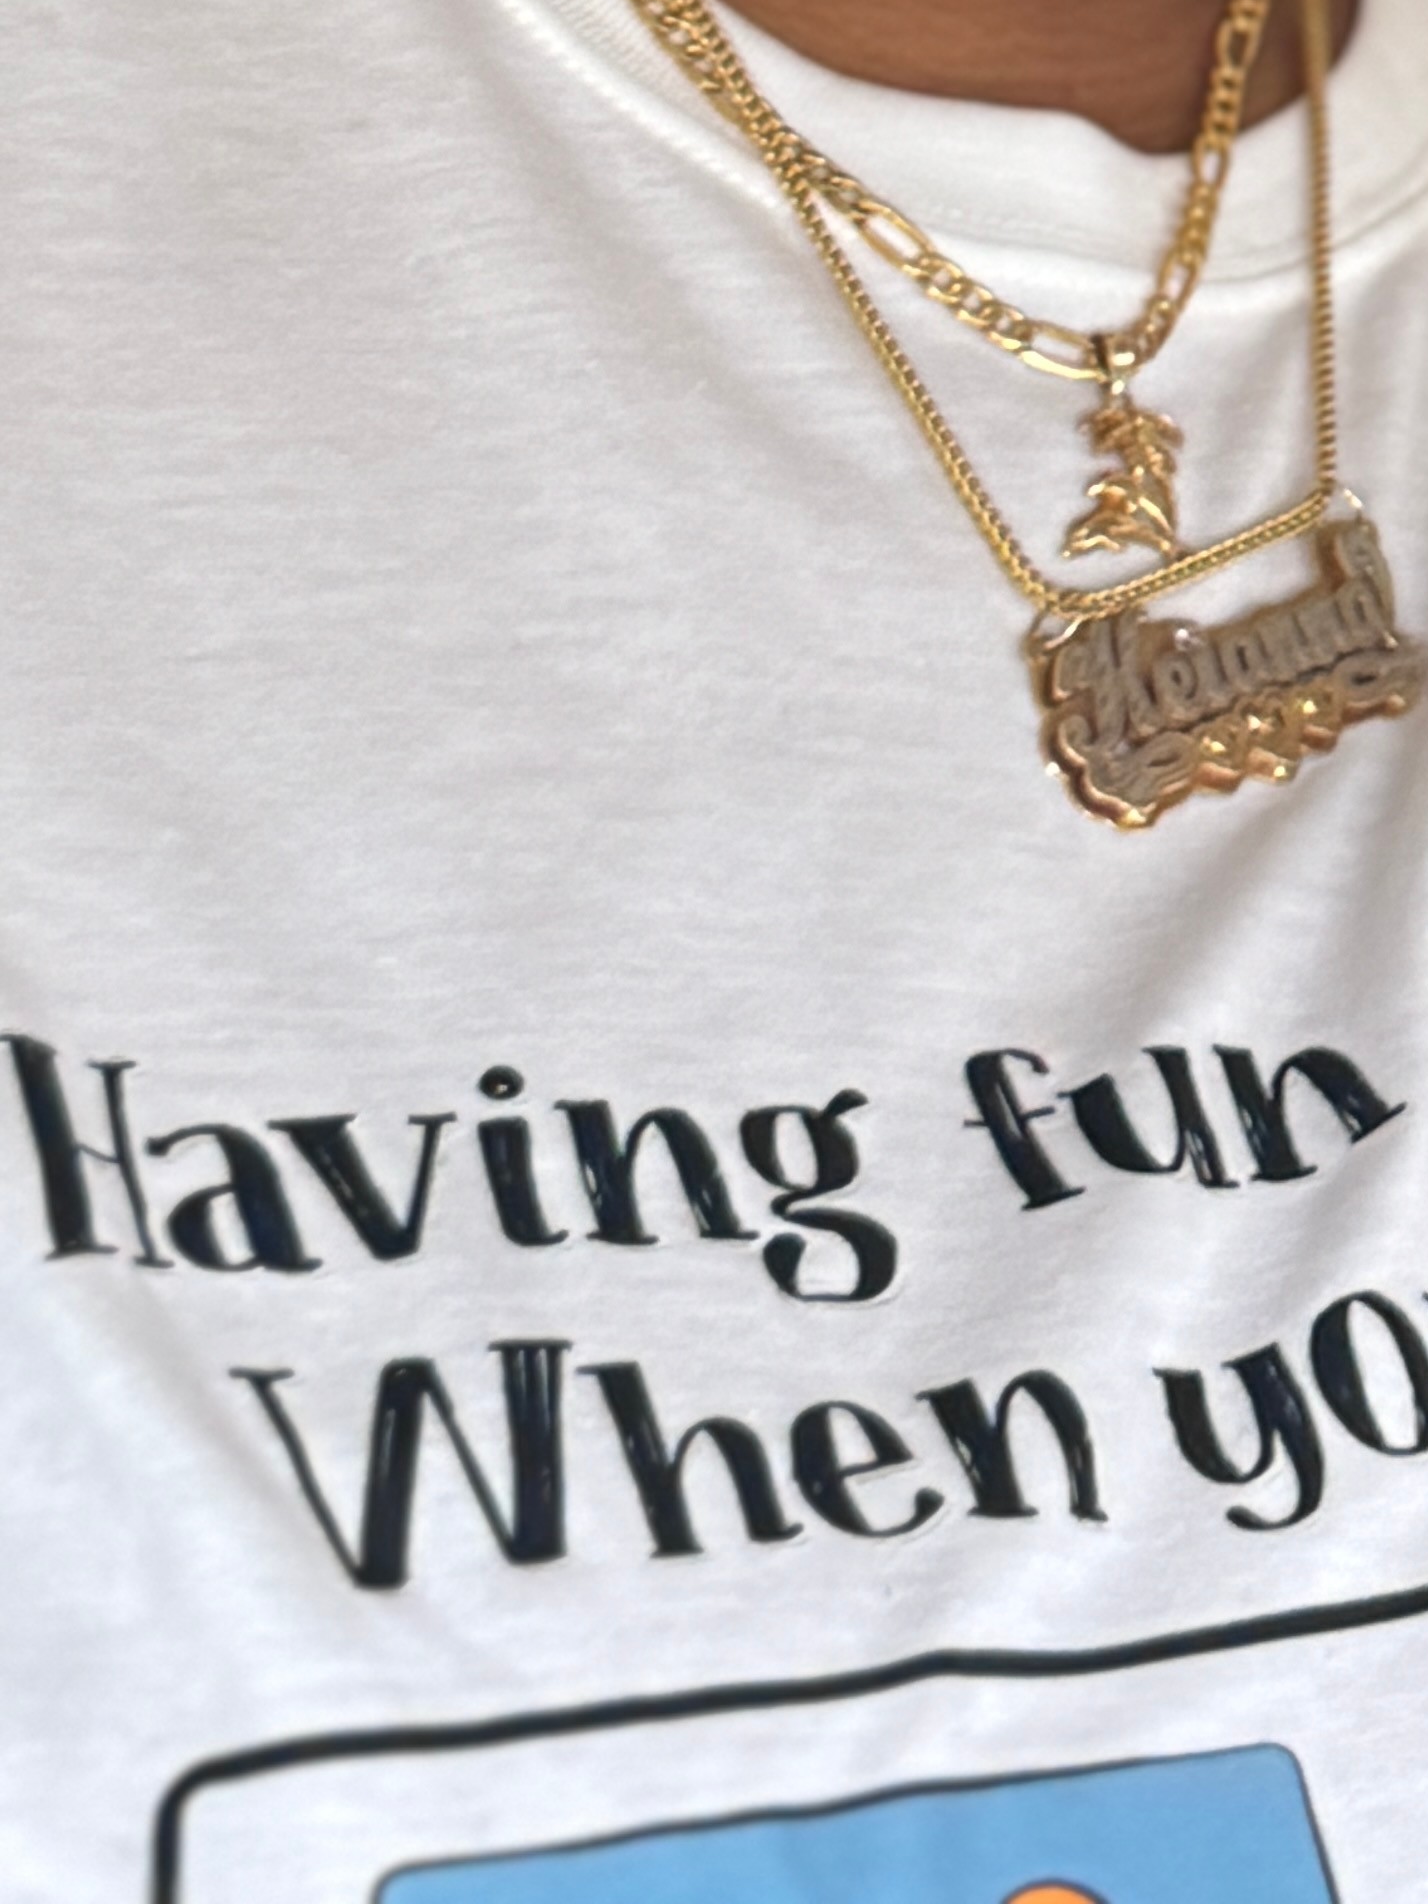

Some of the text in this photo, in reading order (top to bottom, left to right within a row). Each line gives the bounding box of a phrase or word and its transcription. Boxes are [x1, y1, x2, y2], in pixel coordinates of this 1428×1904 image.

[0, 1032, 900, 1302] Having
[963, 1046, 1406, 1210] fun
[230, 1338, 1107, 1590] When
